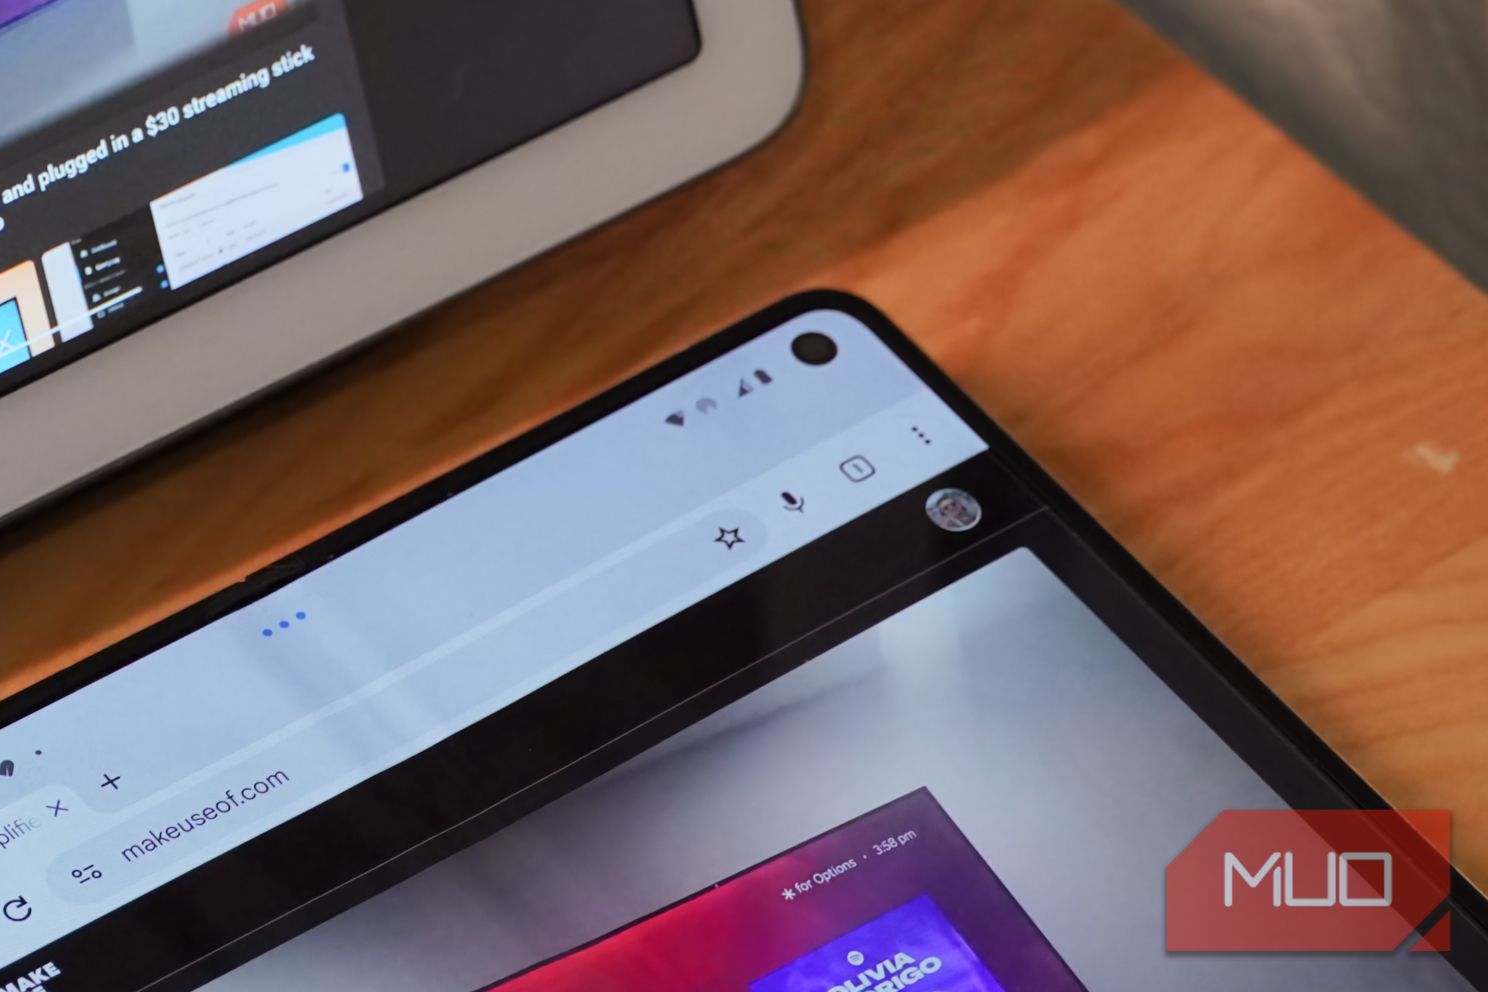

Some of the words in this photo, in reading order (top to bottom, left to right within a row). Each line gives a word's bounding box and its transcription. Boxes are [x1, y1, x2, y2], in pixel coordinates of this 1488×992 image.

[1, 173, 35, 205] and
[37, 139, 109, 192] plugged
[109, 134, 130, 153] in
[131, 127, 144, 143] a
[145, 106, 180, 137] $30
[182, 68, 270, 119] streaming
[271, 44, 315, 77] stick
[121, 770, 290, 863] makeuseof.com
[872, 837, 899, 856] 3:58
[897, 830, 917, 846] pm
[794, 878, 812, 894] for
[812, 858, 857, 884] Options
